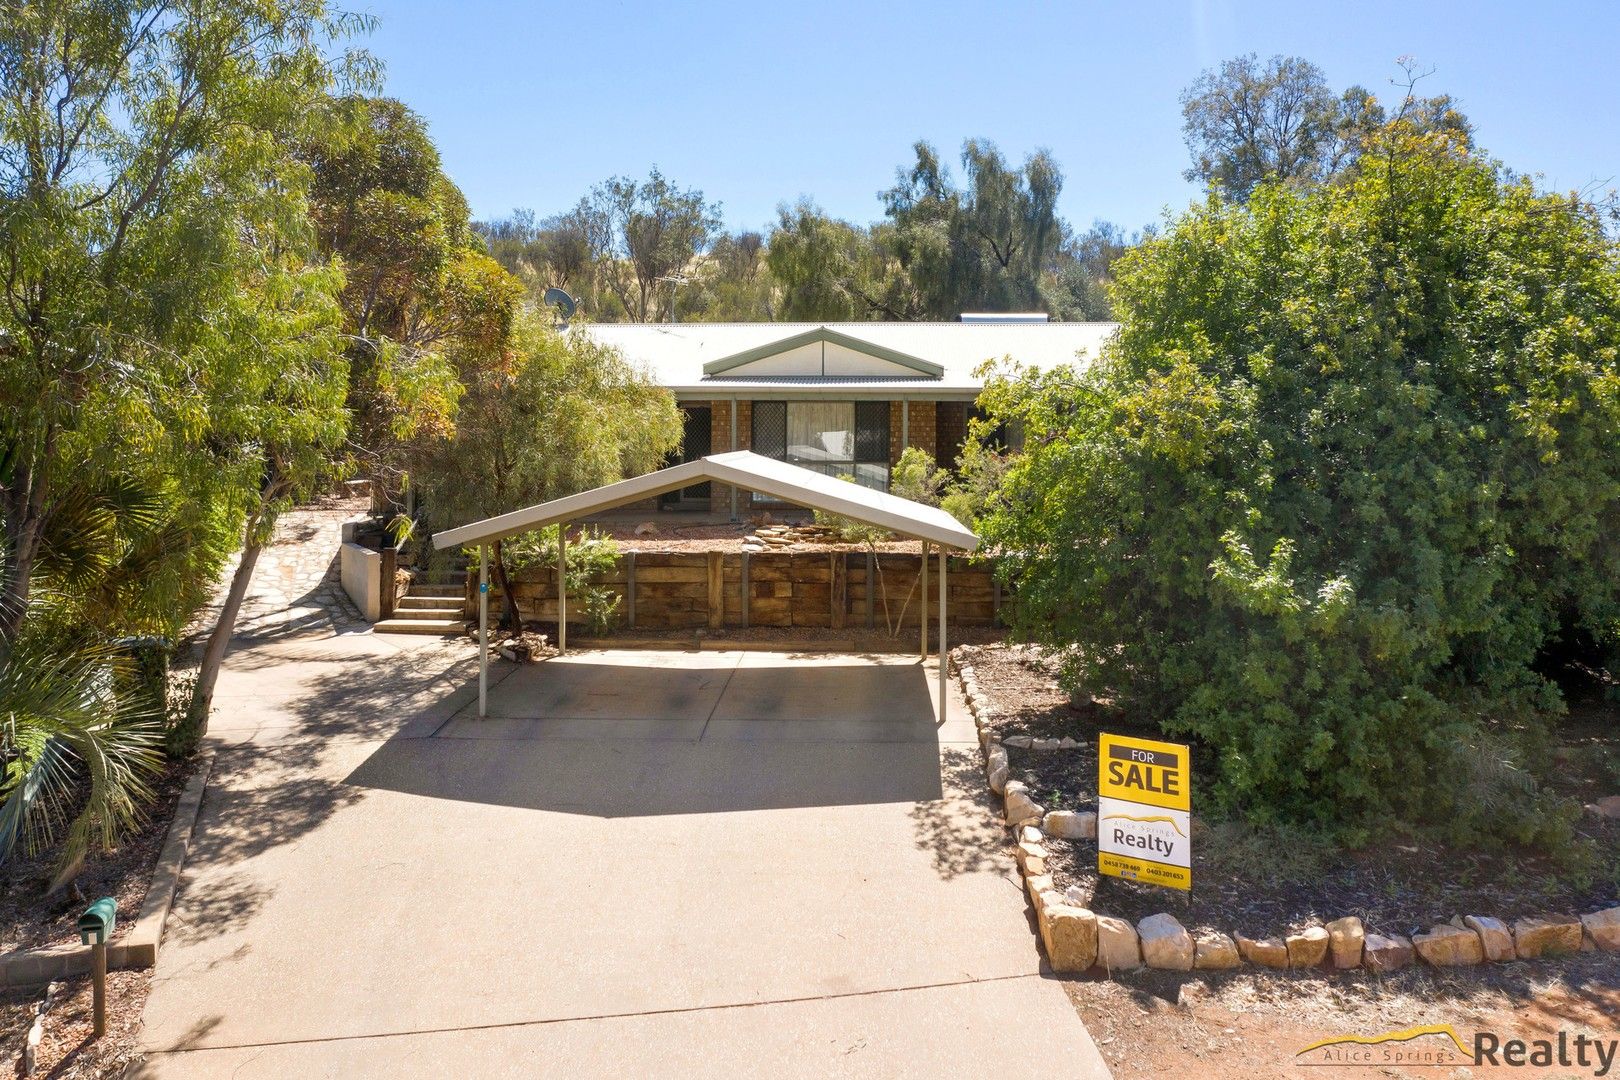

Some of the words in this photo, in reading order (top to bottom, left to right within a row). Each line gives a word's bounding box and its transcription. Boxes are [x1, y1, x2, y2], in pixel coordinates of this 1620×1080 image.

[1131, 750, 1154, 764] FOR
[1108, 761, 1180, 796] SALE
[1114, 820, 1136, 830] Alice
[1141, 825, 1175, 838] Springs
[1113, 829, 1174, 858] Realty
